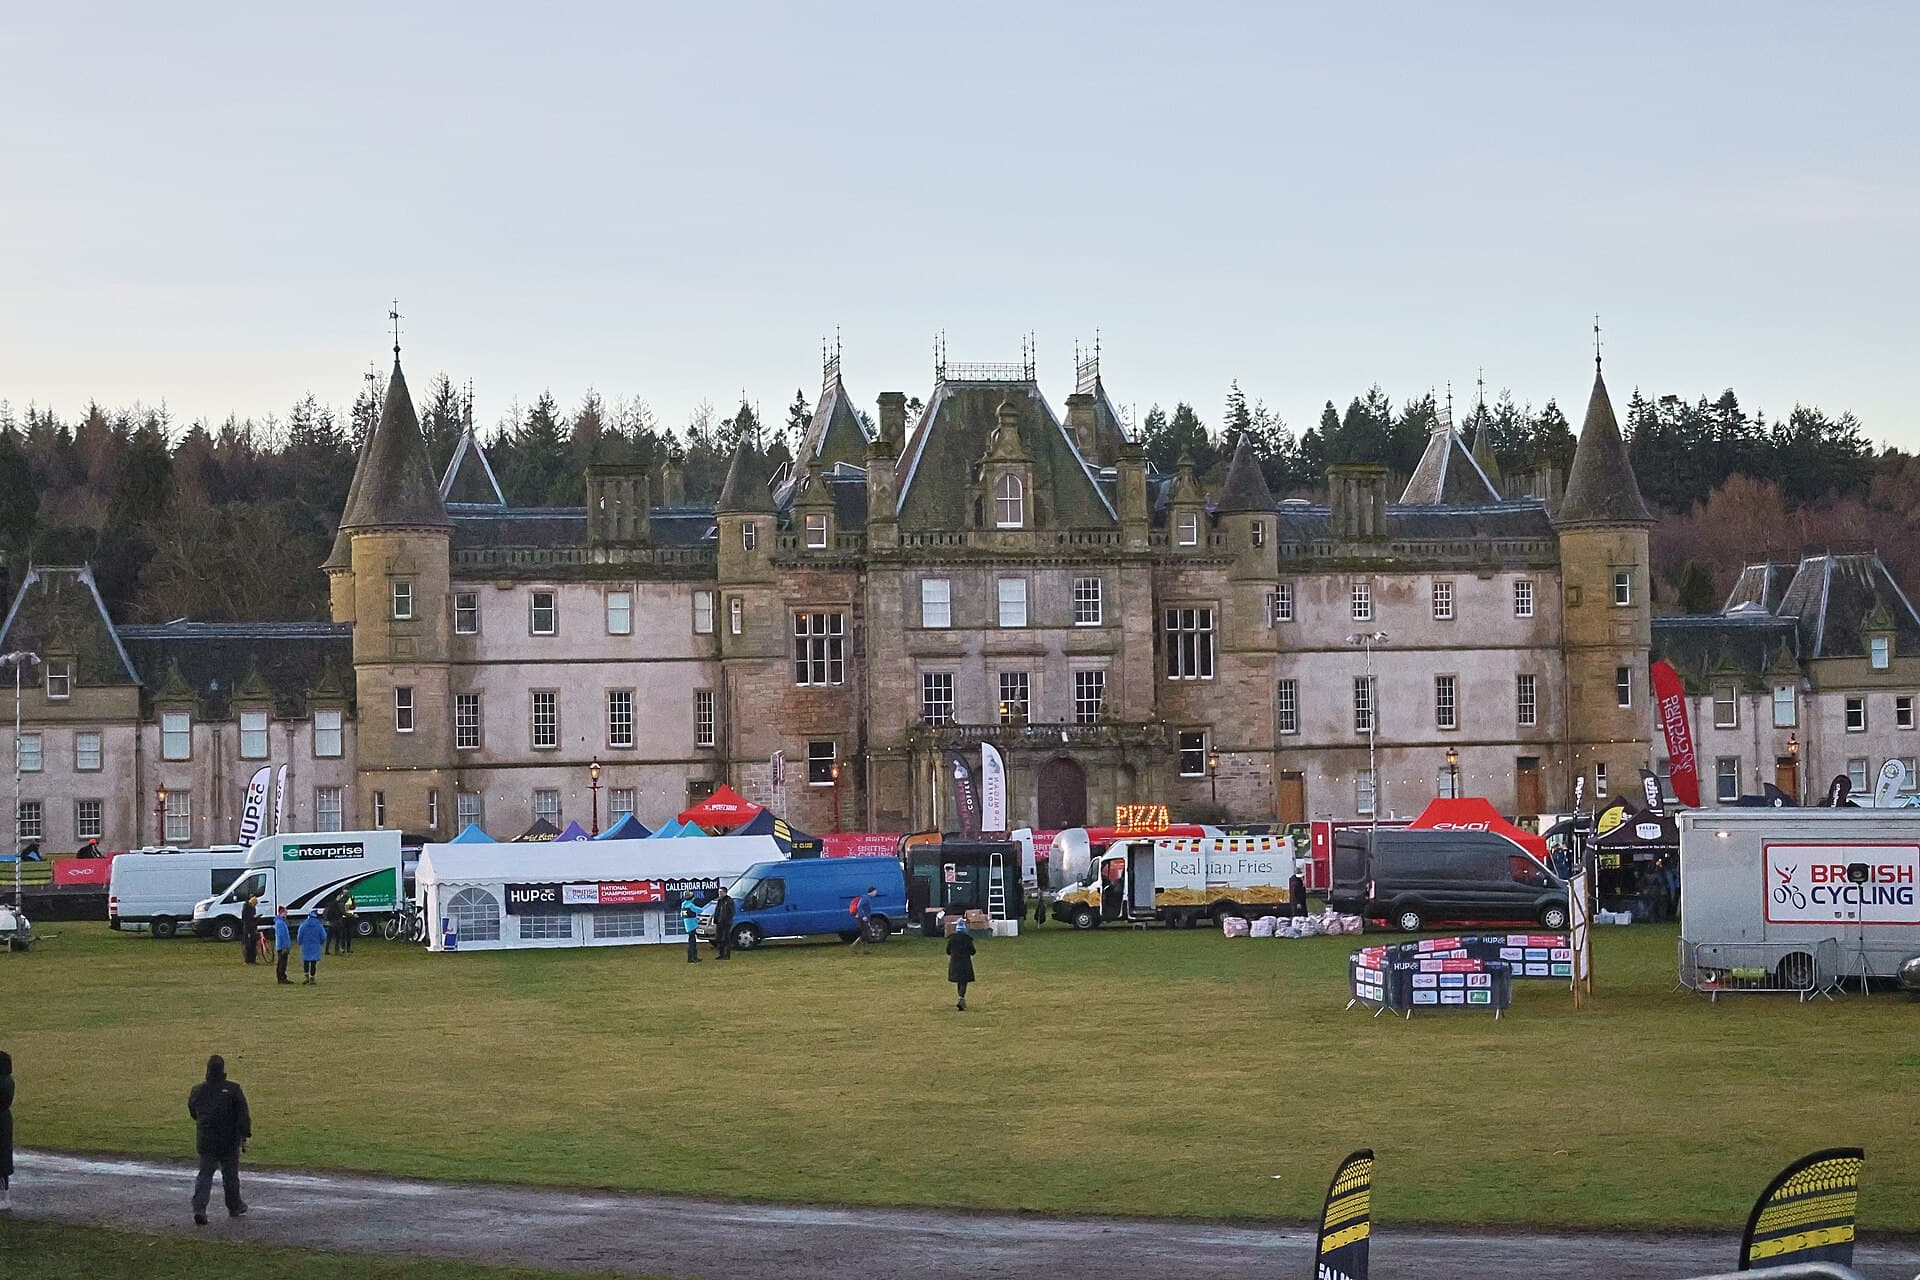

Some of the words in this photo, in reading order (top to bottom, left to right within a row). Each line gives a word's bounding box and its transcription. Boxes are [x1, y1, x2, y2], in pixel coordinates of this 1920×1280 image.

[1670, 694, 1689, 754] CYCLING
[963, 780, 974, 811] COFFEE
[1116, 805, 1169, 827] PIZZA
[284, 845, 363, 858] enterprise
[1170, 857, 1200, 875] Real
[1238, 859, 1273, 873] Fries
[1810, 864, 1913, 884] BRISH
[601, 889, 648, 897] CHAMPIONSHIPS
[665, 881, 701, 891] CALLENDAR
[702, 880, 718, 890] PARK
[1810, 886, 1914, 905] CYCLING
